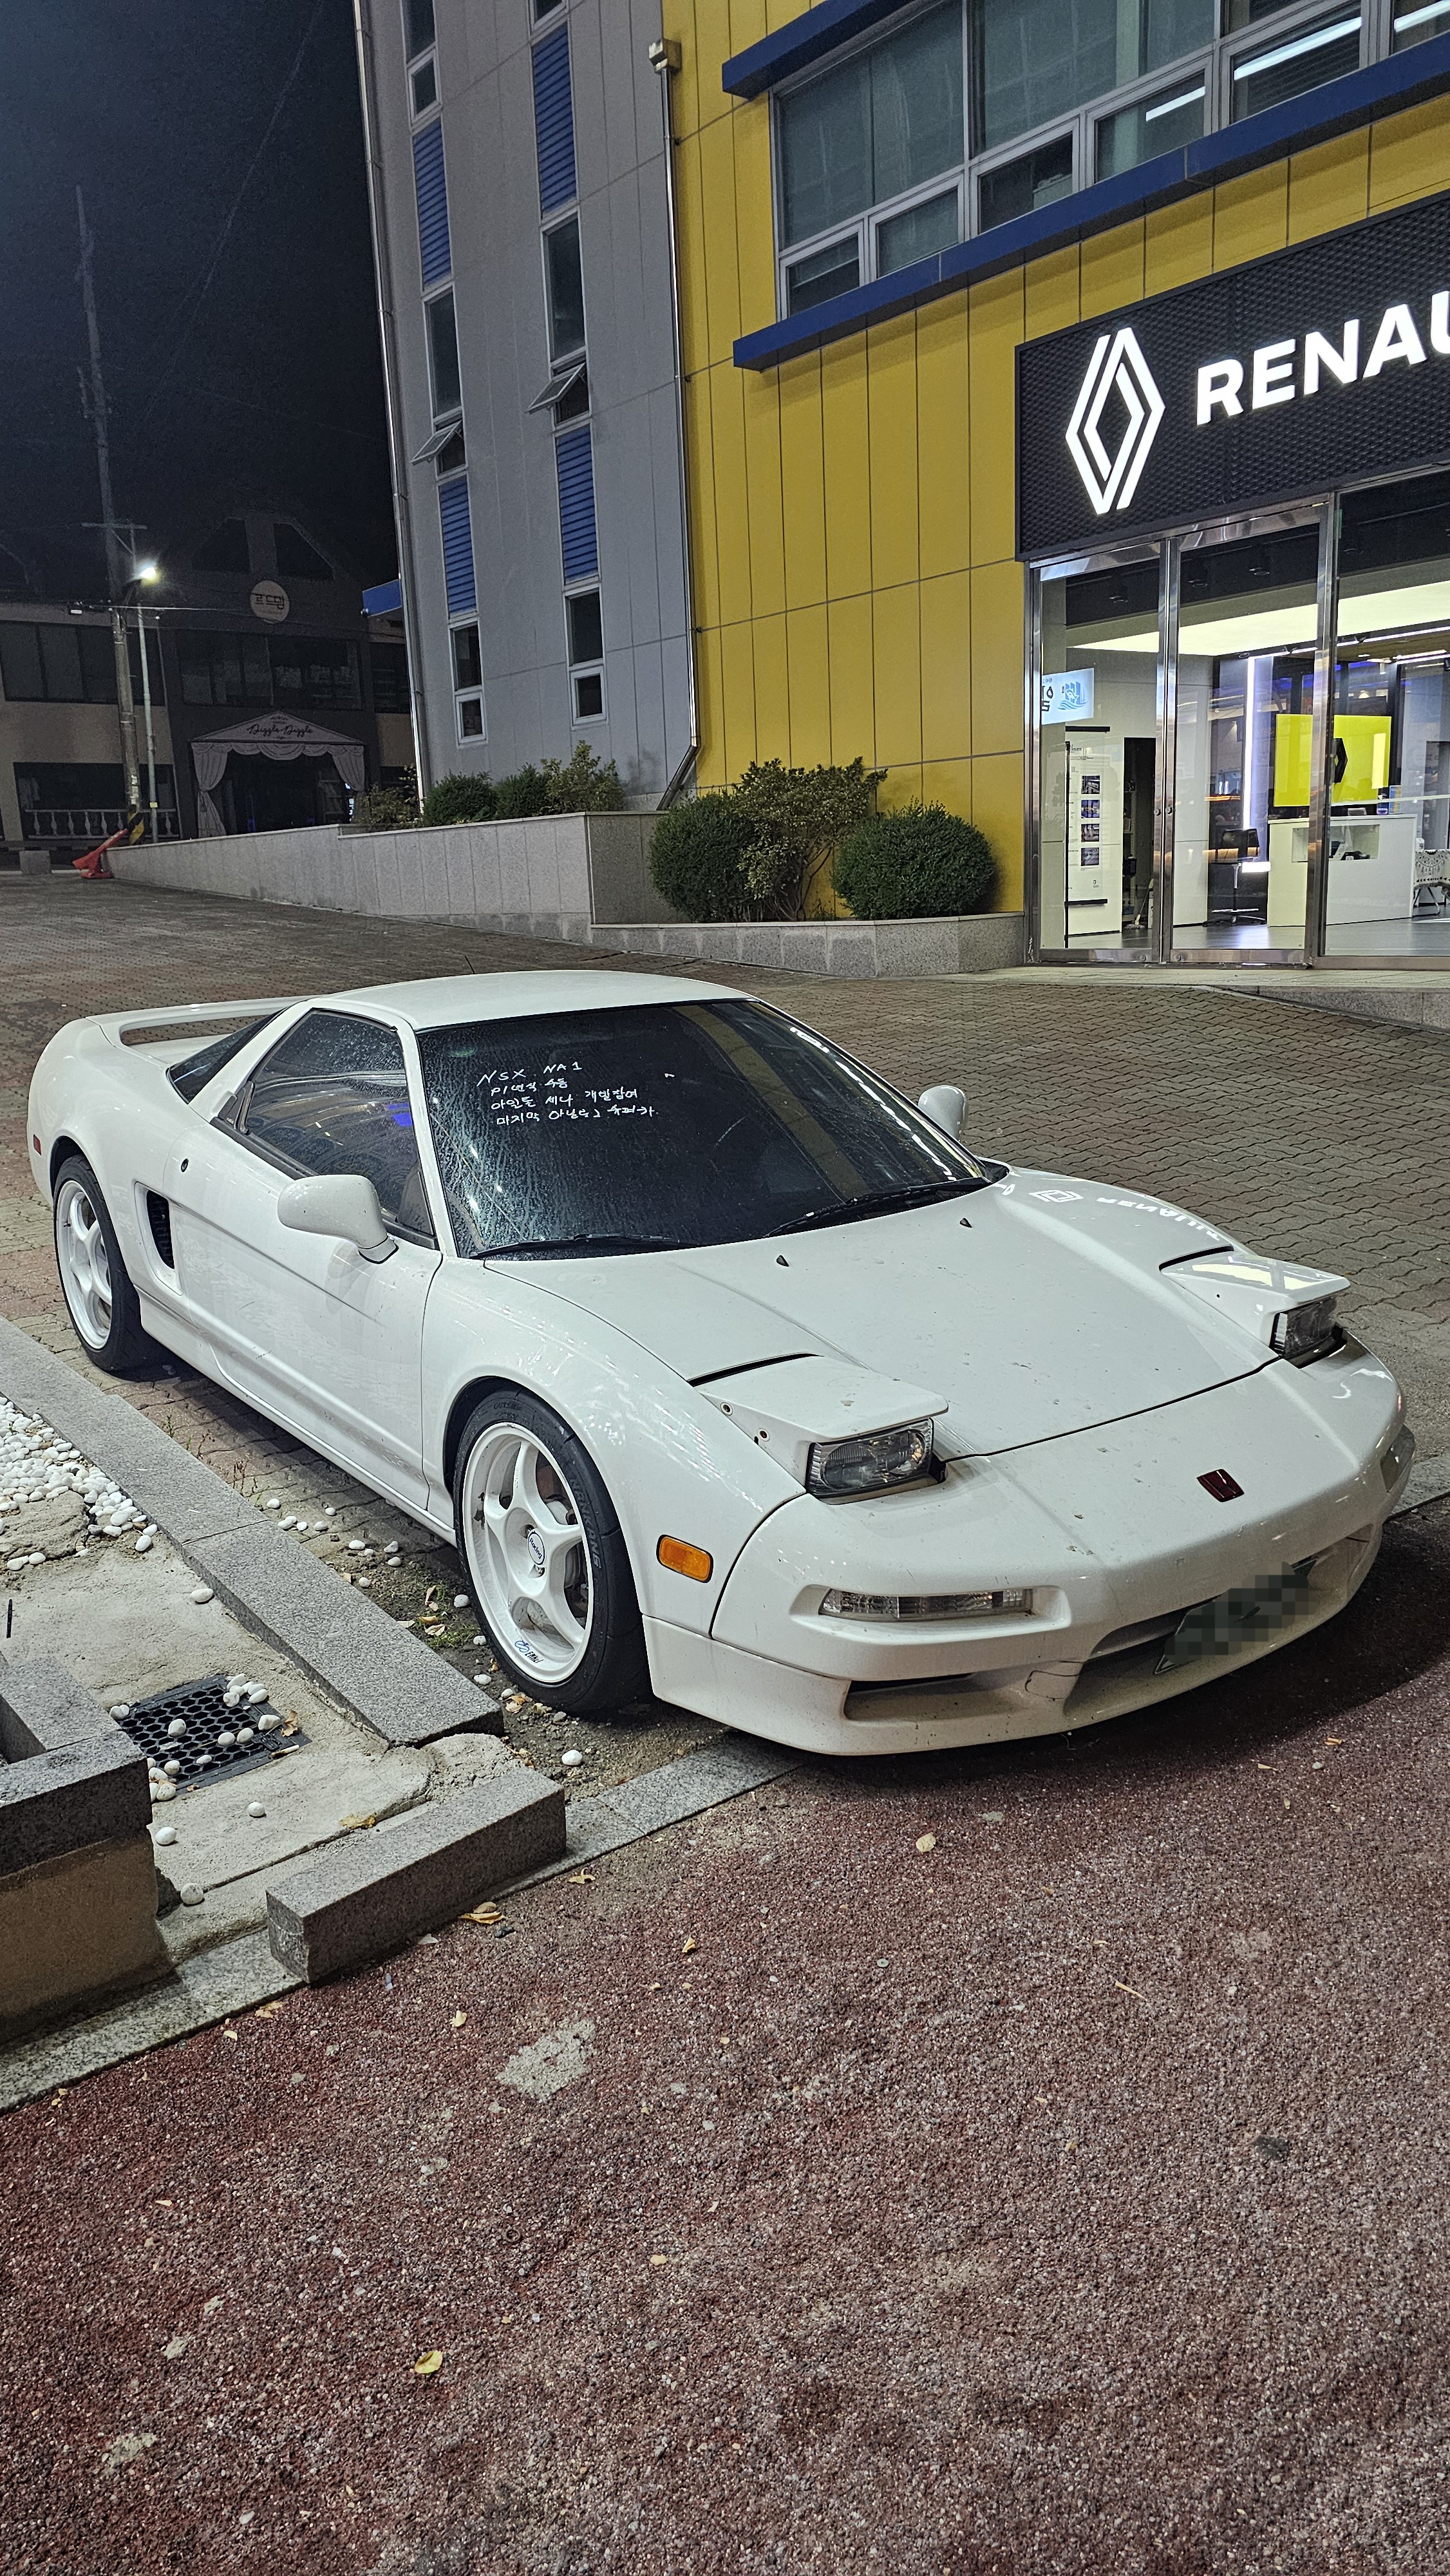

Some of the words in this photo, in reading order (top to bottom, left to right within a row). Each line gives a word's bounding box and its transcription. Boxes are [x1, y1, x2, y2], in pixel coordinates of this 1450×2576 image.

[476, 1069, 526, 1086] NSX
[545, 1077, 568, 1088] 수동
[491, 1095, 536, 1110] 아일톤
[545, 1094, 573, 1107] 세나
[496, 1112, 540, 1126] 마지막
[569, 1479, 602, 1569] NANKANG
[529, 1537, 543, 1560] Racing
